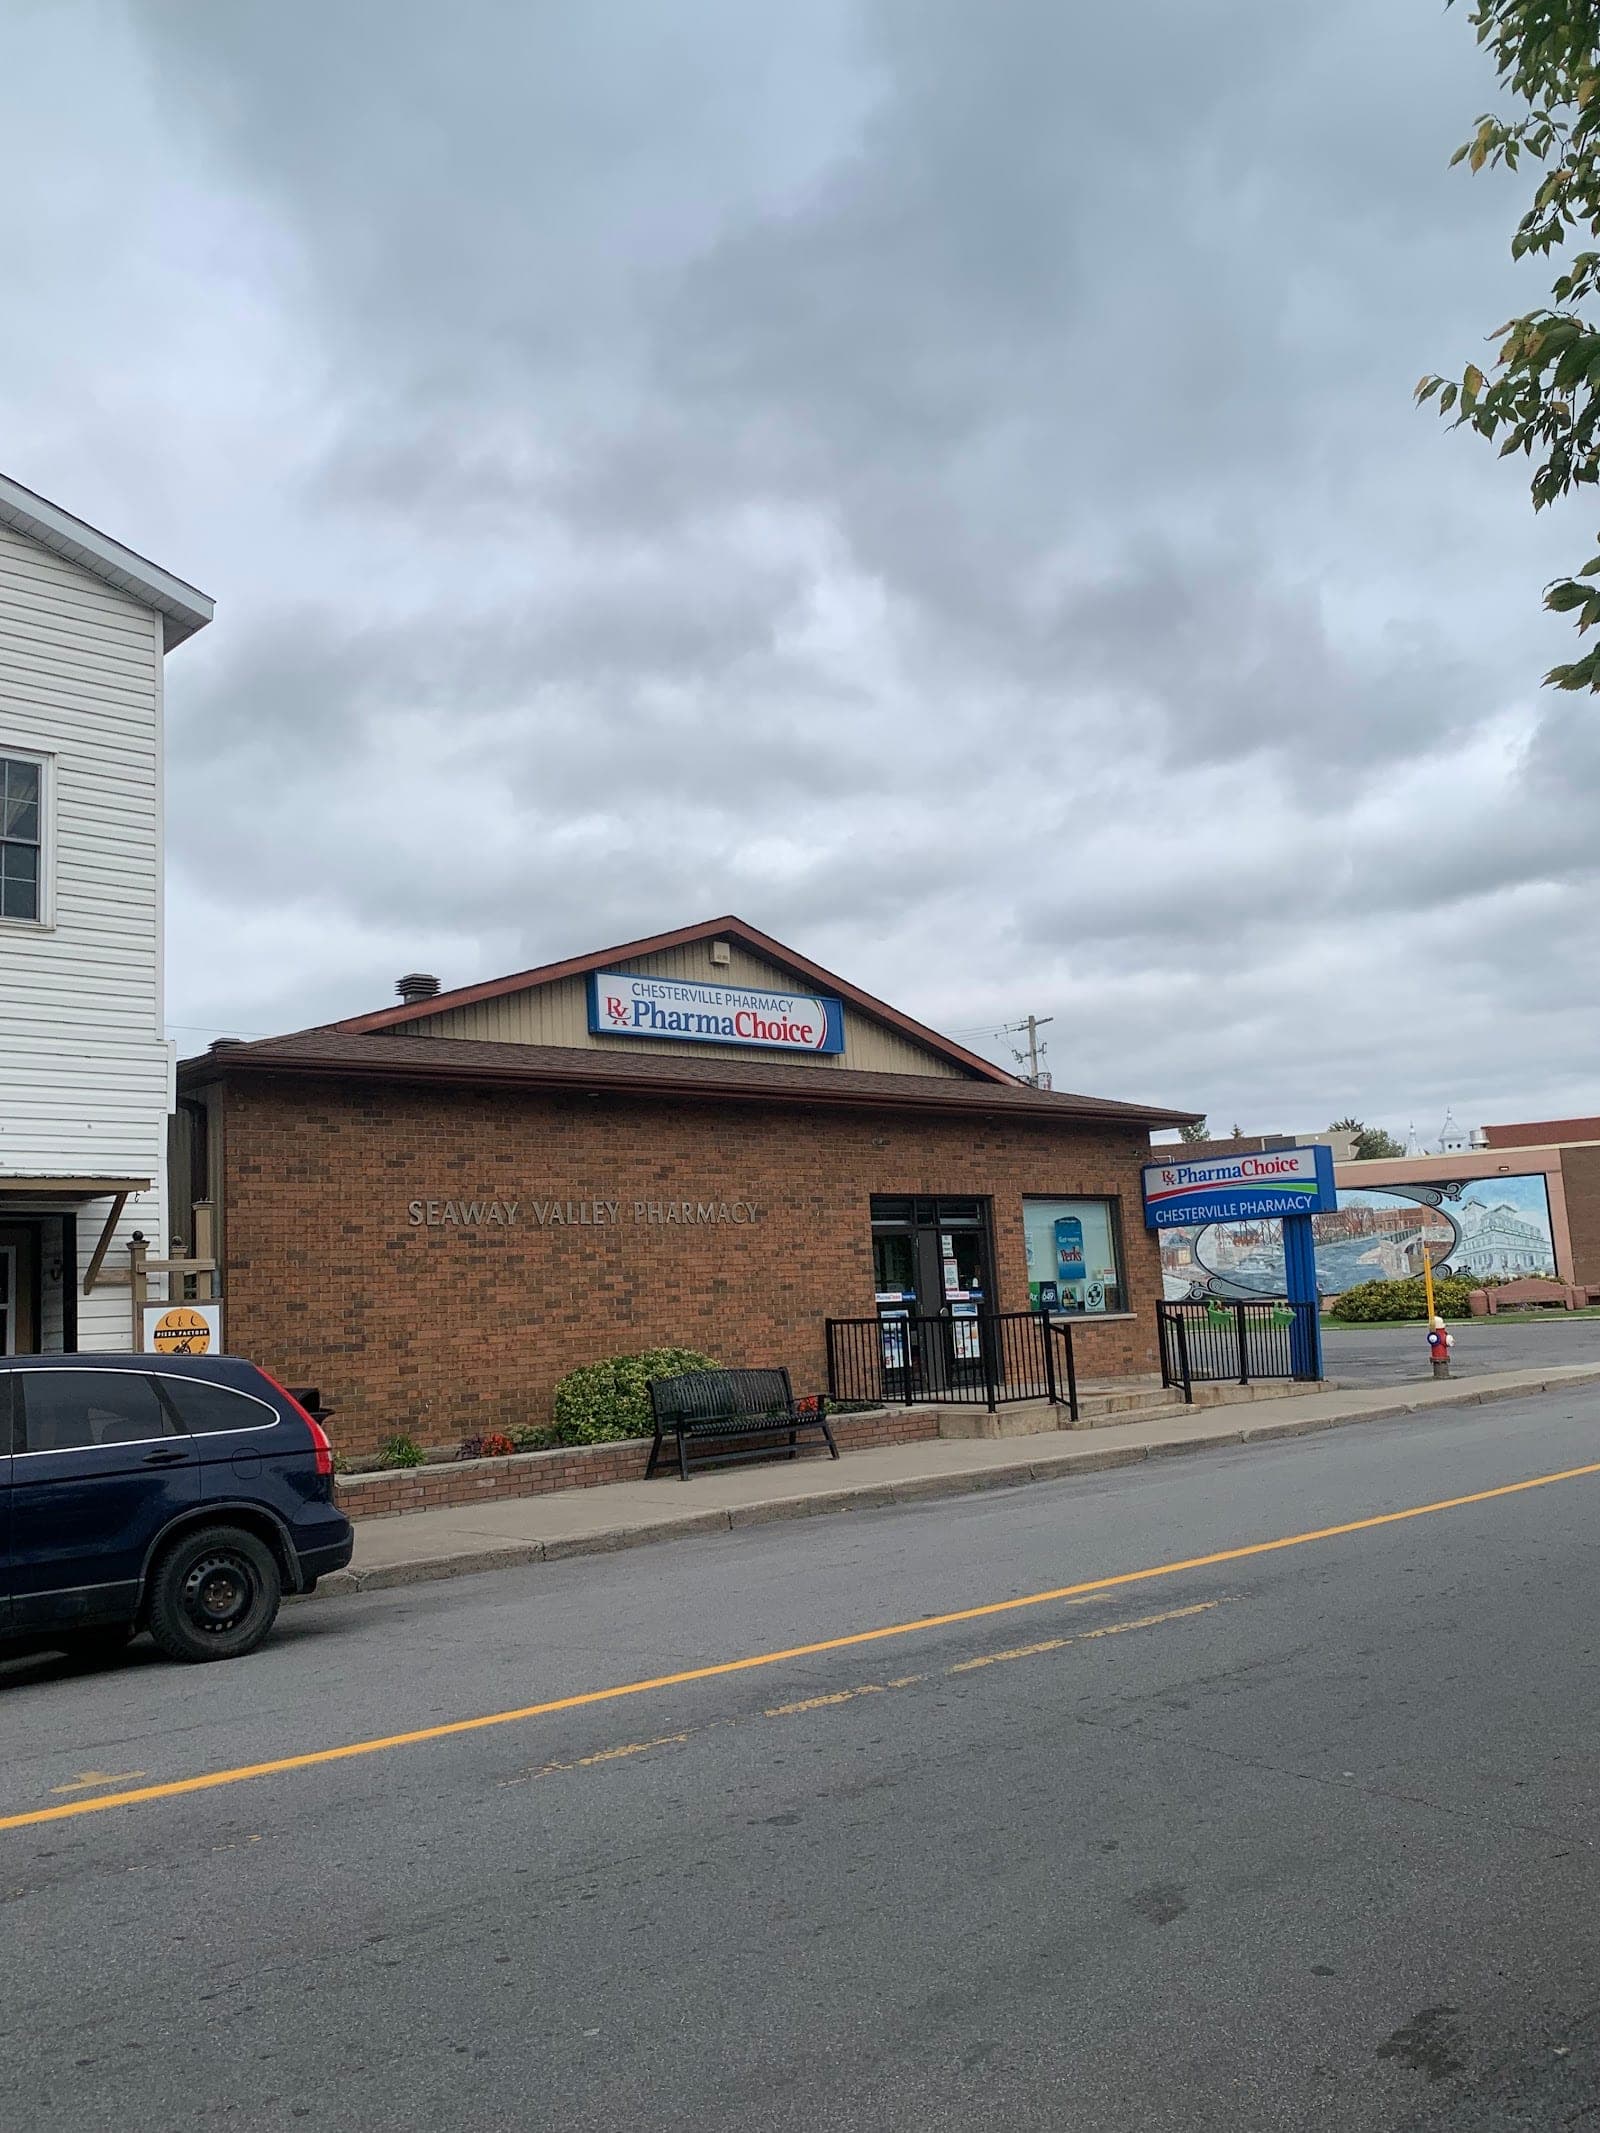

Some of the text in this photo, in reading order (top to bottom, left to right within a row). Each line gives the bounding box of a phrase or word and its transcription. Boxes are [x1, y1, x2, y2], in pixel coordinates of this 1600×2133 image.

[631, 982, 794, 1013] CHESTERVILLE PHARMACY
[631, 999, 813, 1044] PharmaChoice
[1176, 1156, 1299, 1185] PharmaChoice
[408, 1200, 760, 1227] SEAWAY VALLEY PHARMACY
[1155, 1195, 1313, 1223] CHESTERVILLE PHARMACY
